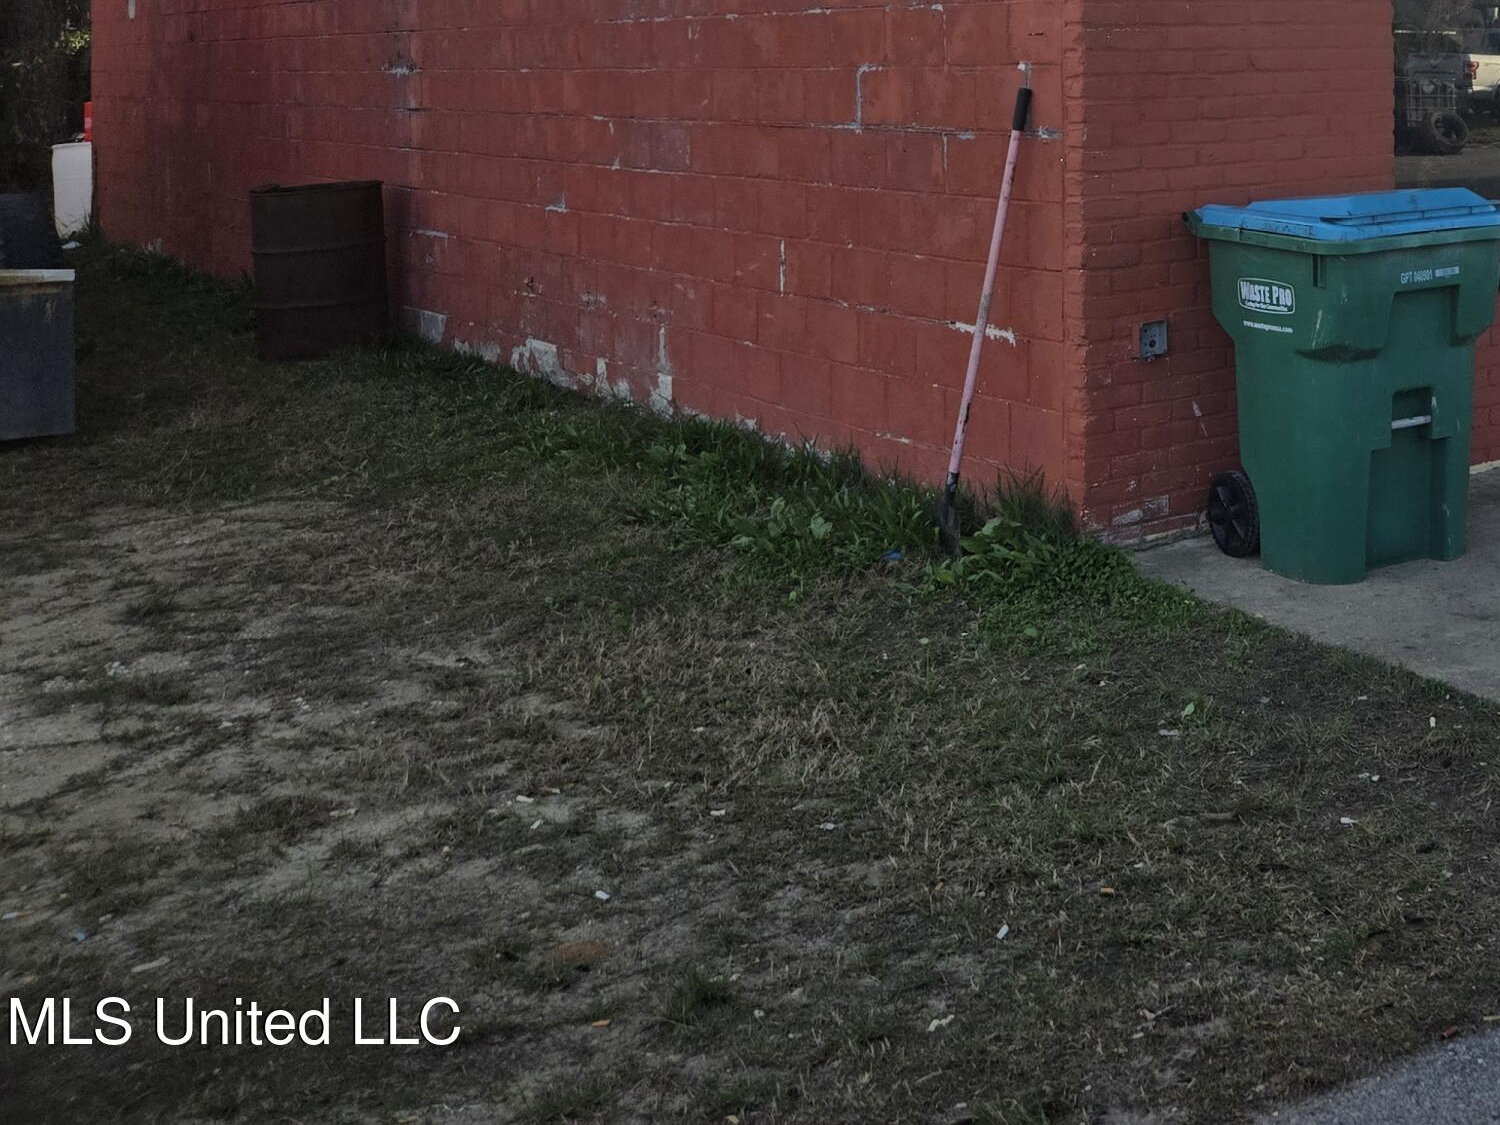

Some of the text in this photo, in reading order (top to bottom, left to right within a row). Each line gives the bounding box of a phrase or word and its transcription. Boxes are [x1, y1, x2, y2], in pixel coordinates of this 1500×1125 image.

[1400, 271, 1413, 284] GPT
[1240, 281, 1271, 304] WASTE
[1271, 285, 1292, 307] PRO
